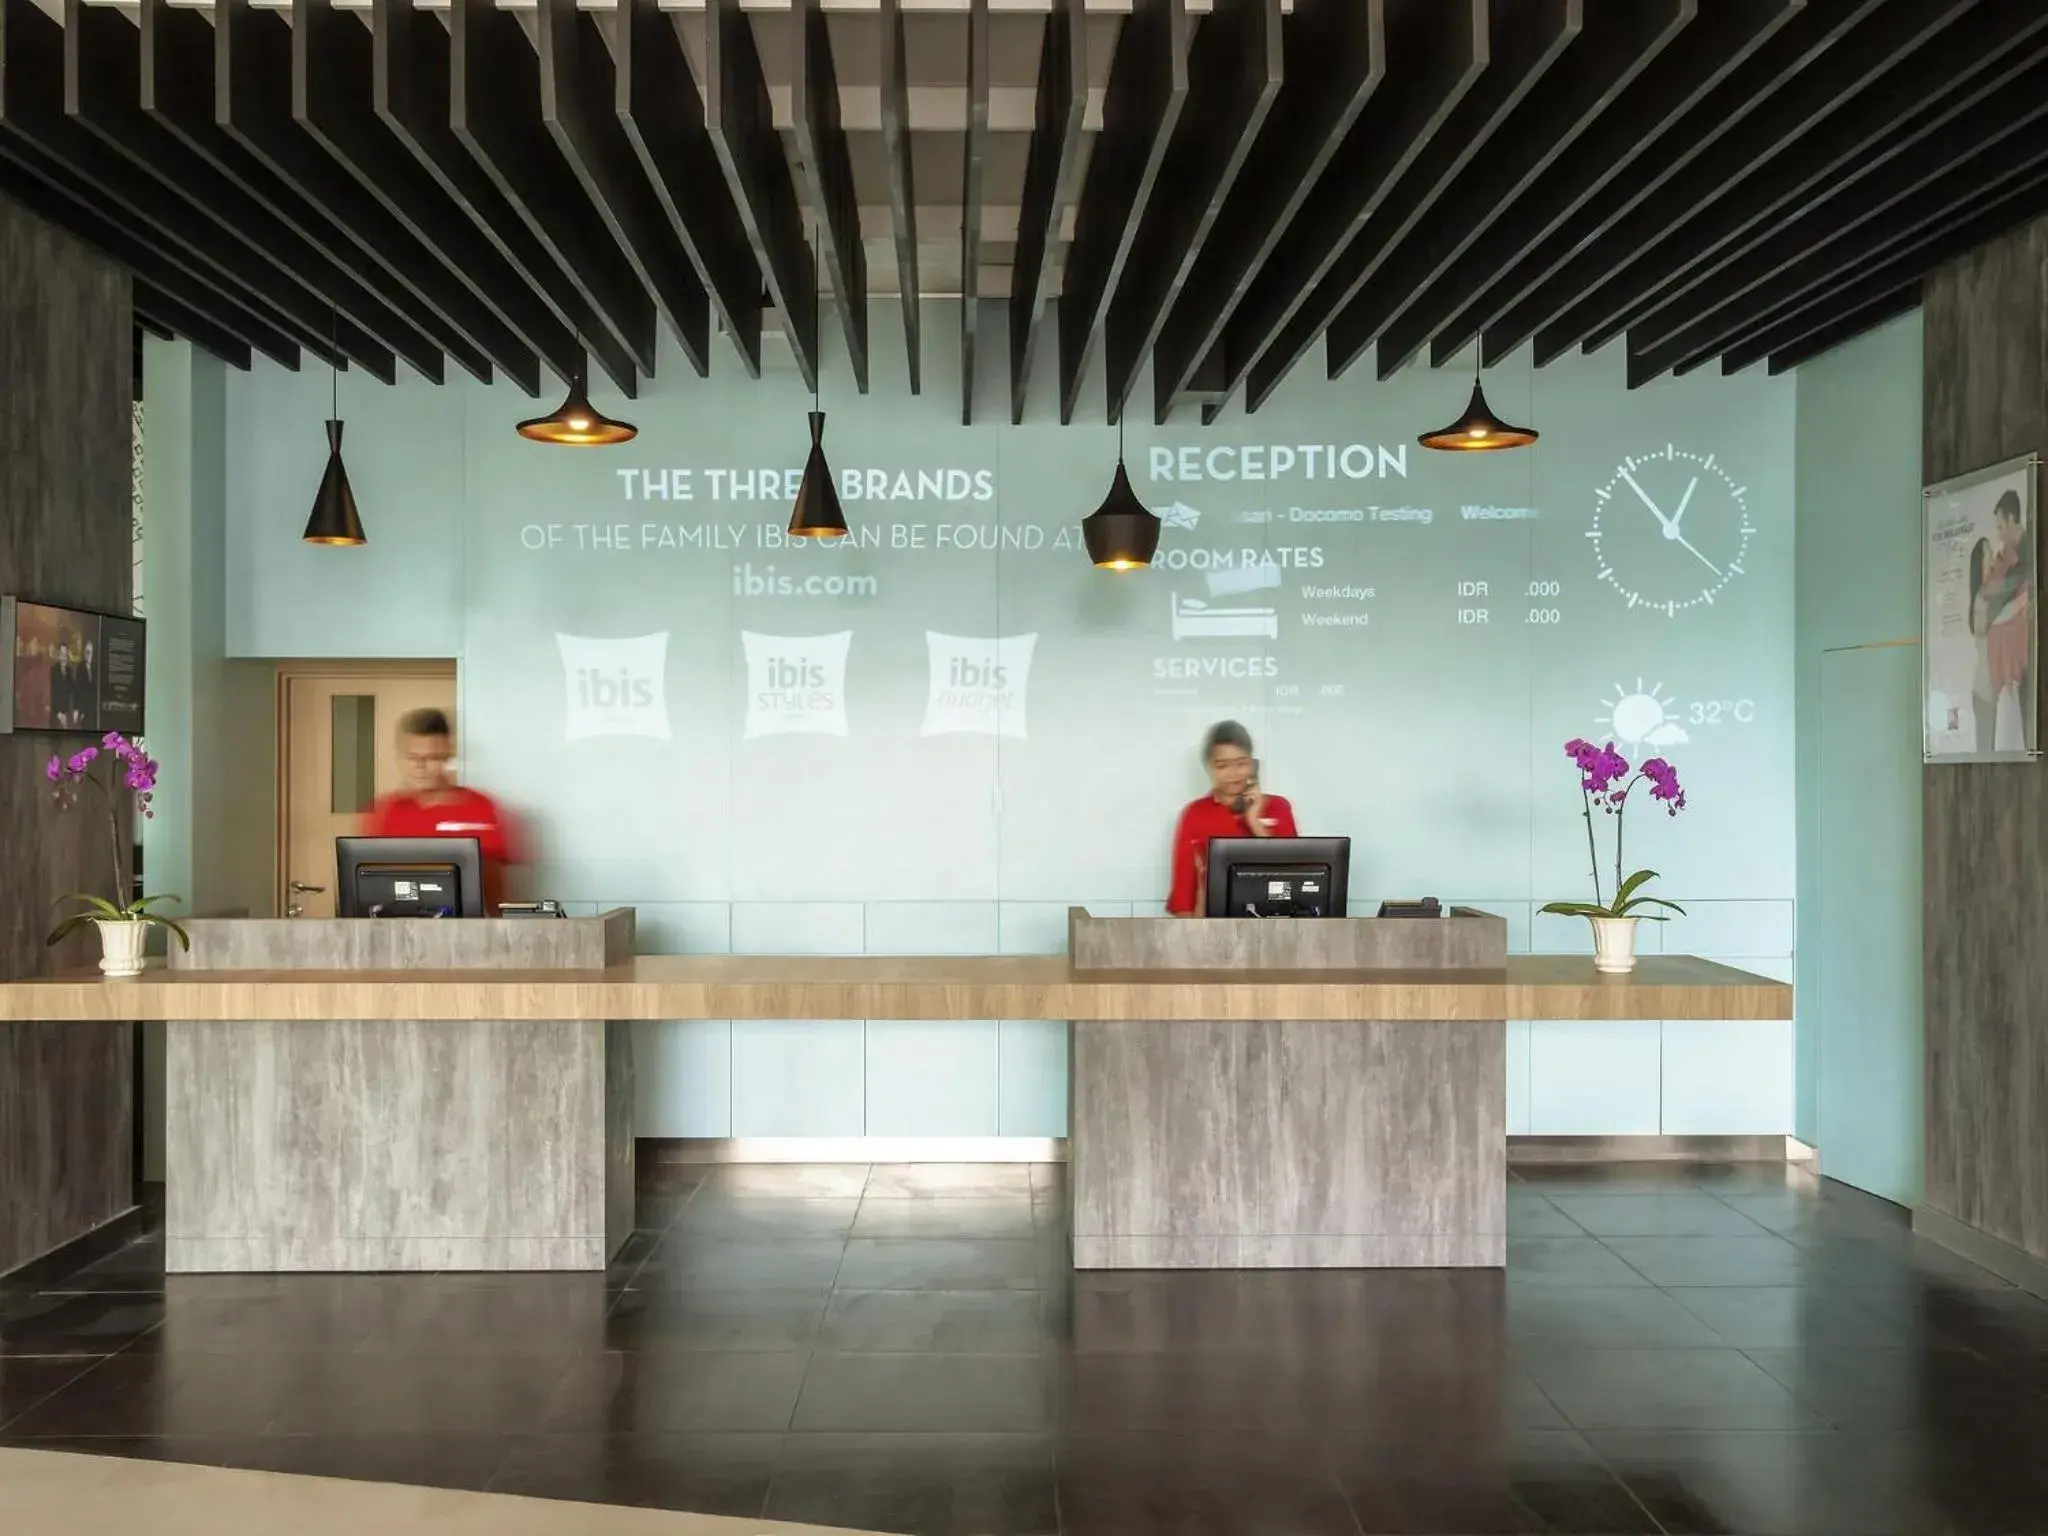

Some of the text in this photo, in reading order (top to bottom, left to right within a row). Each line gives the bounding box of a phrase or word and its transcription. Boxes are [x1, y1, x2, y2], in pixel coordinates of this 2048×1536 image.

[1150, 444, 1408, 481] RECEPTION
[616, 468, 994, 501] THE THRE BRANDS
[521, 524, 563, 550] OF
[572, 524, 631, 550] THE
[641, 524, 747, 550] FAMILY
[891, 524, 927, 549] BE
[936, 524, 1044, 550] FOUND
[1151, 547, 1324, 569] ROOM RATES
[733, 562, 877, 596] ibis.com
[1301, 581, 1560, 600] Weekdays IDR .000
[1301, 609, 1560, 627] Weekend IDR .000
[767, 657, 825, 689] ibis
[950, 657, 1007, 689] ibis
[1152, 657, 1278, 678] SERVICES
[577, 667, 653, 708] ibis
